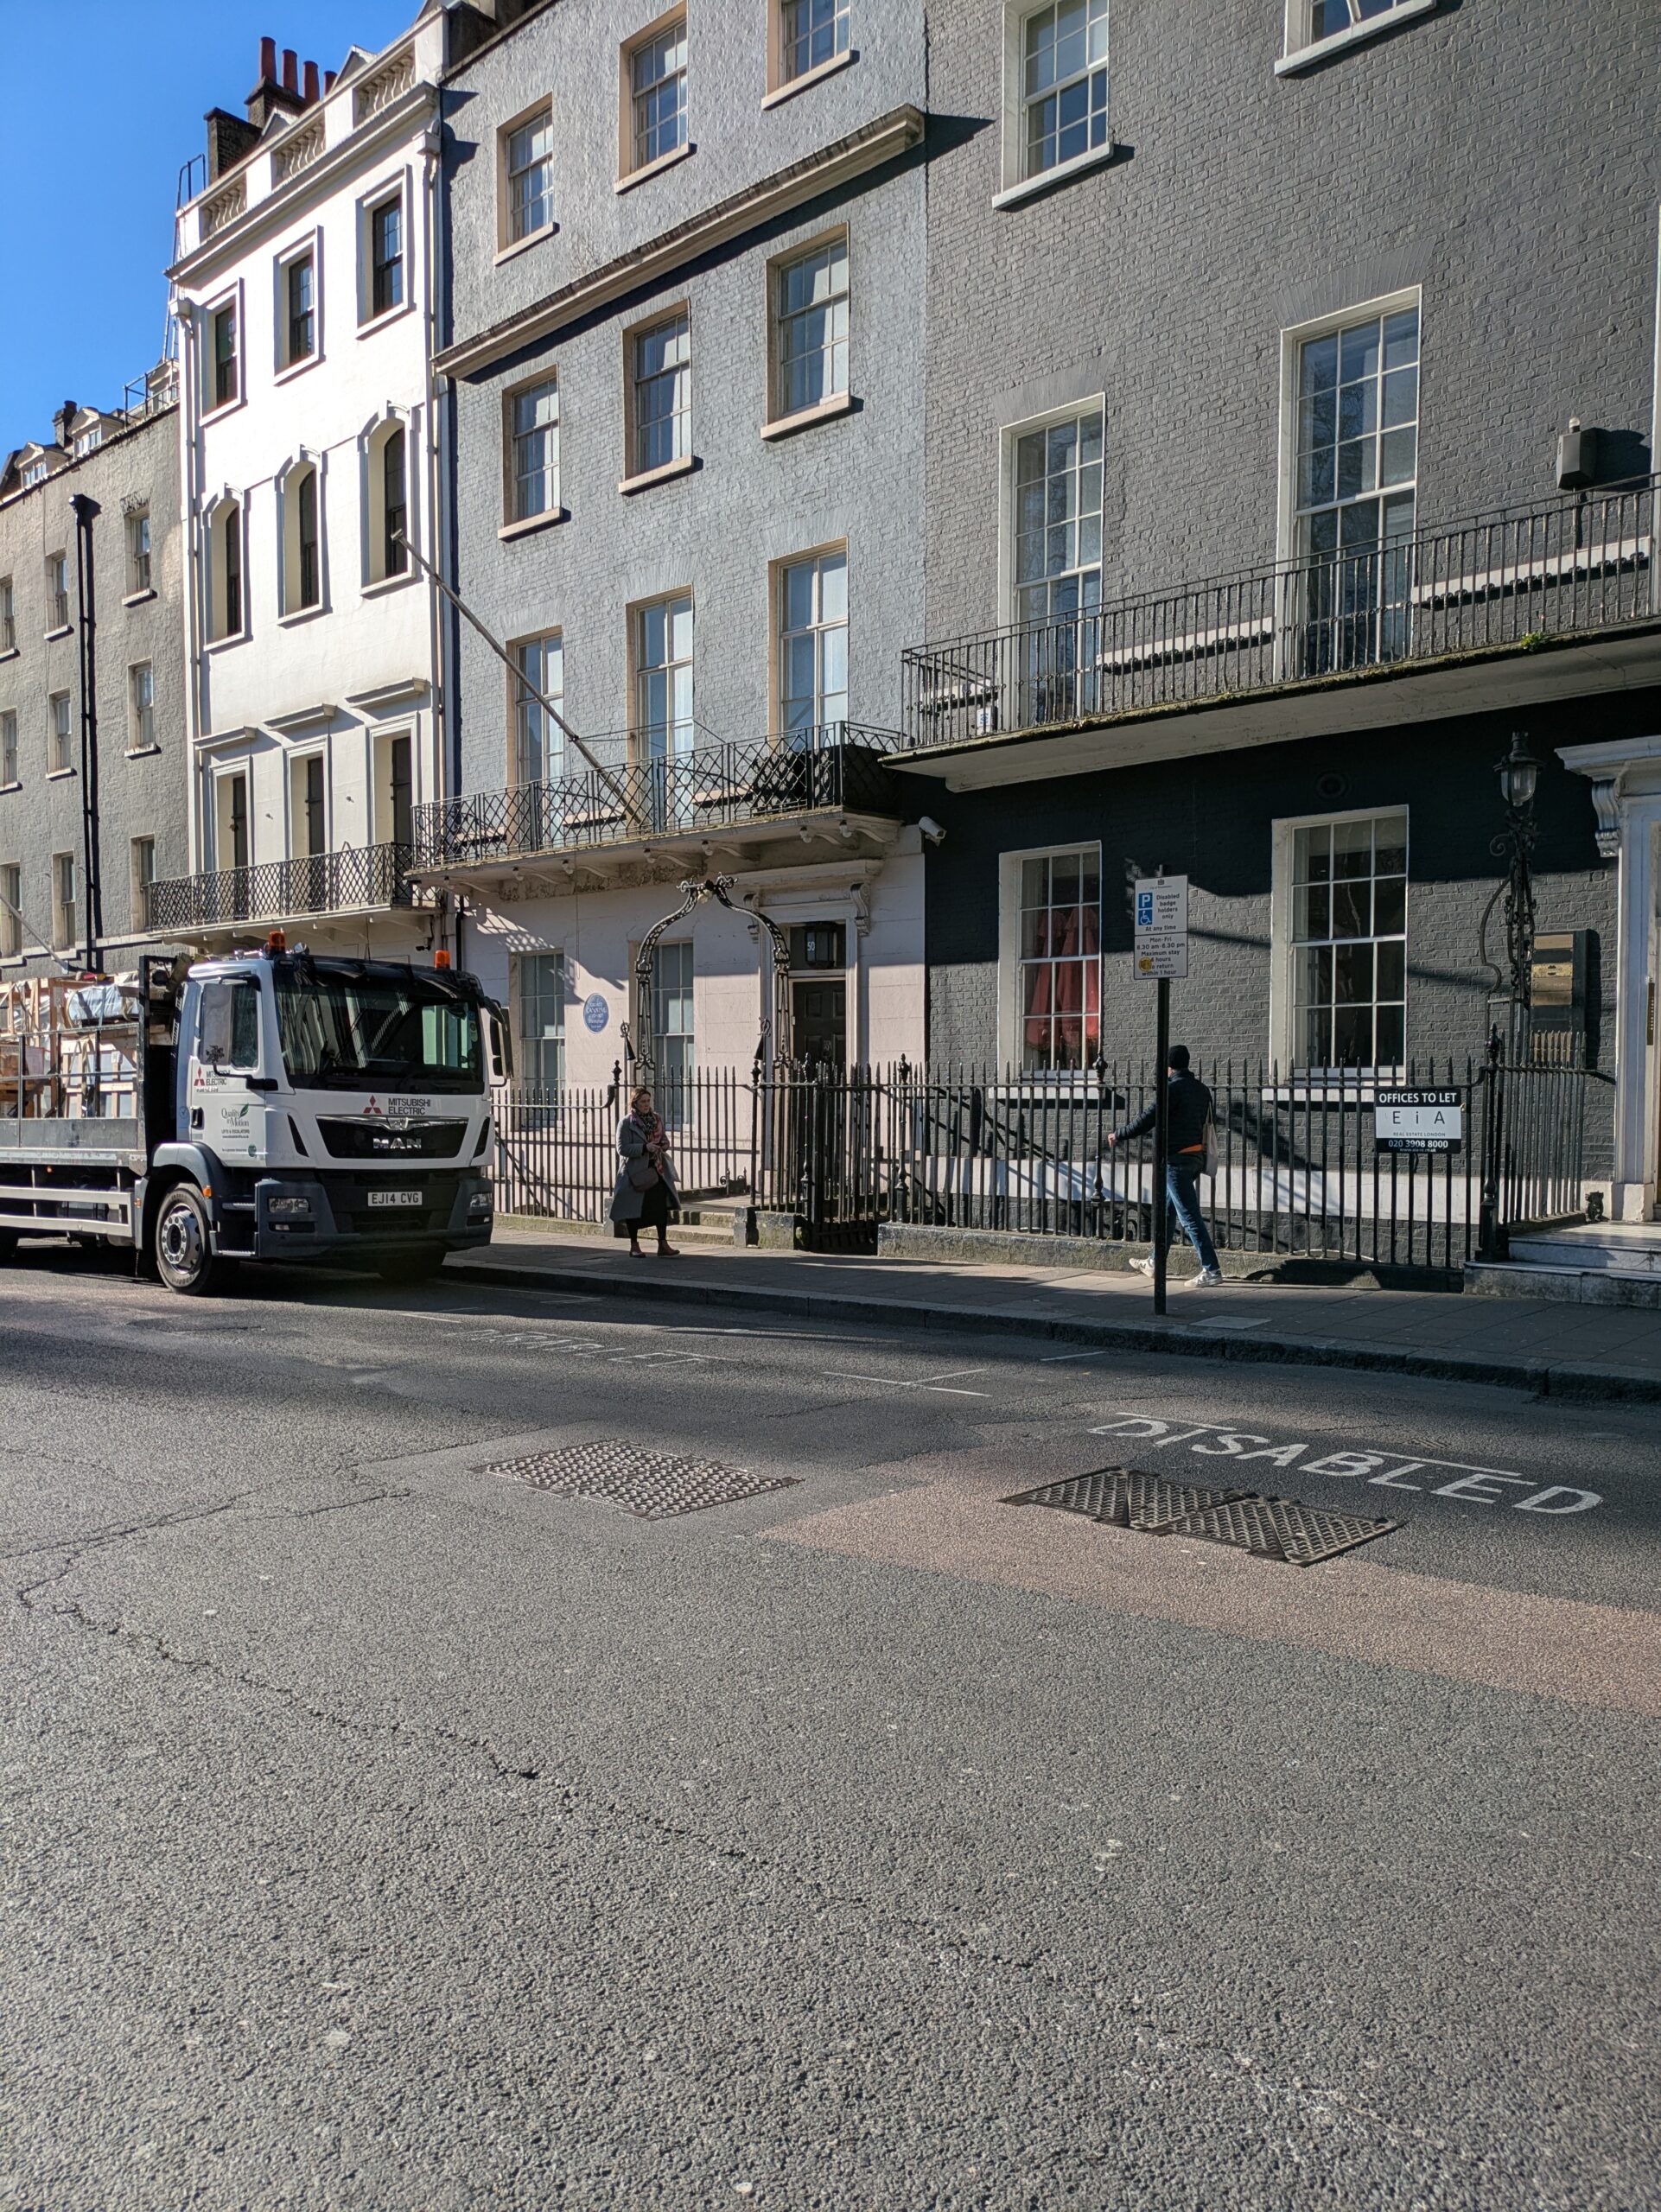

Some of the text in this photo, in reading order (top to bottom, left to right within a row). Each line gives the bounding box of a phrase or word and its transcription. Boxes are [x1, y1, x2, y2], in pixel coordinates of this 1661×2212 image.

[806, 941, 816, 951] 50
[206, 1077, 227, 1086] ELECTRIC
[388, 1097, 431, 1107] MITSUBISHI
[1378, 1092, 1457, 1103] OFFICES TO LET
[388, 1106, 426, 1115] ELECTRIC
[372, 1137, 422, 1149] MAN
[1388, 1139, 1449, 1148] 020 3908 8000
[372, 1193, 419, 1205] EJ14 CVG
[1086, 1417, 1604, 1515] DISABLED
